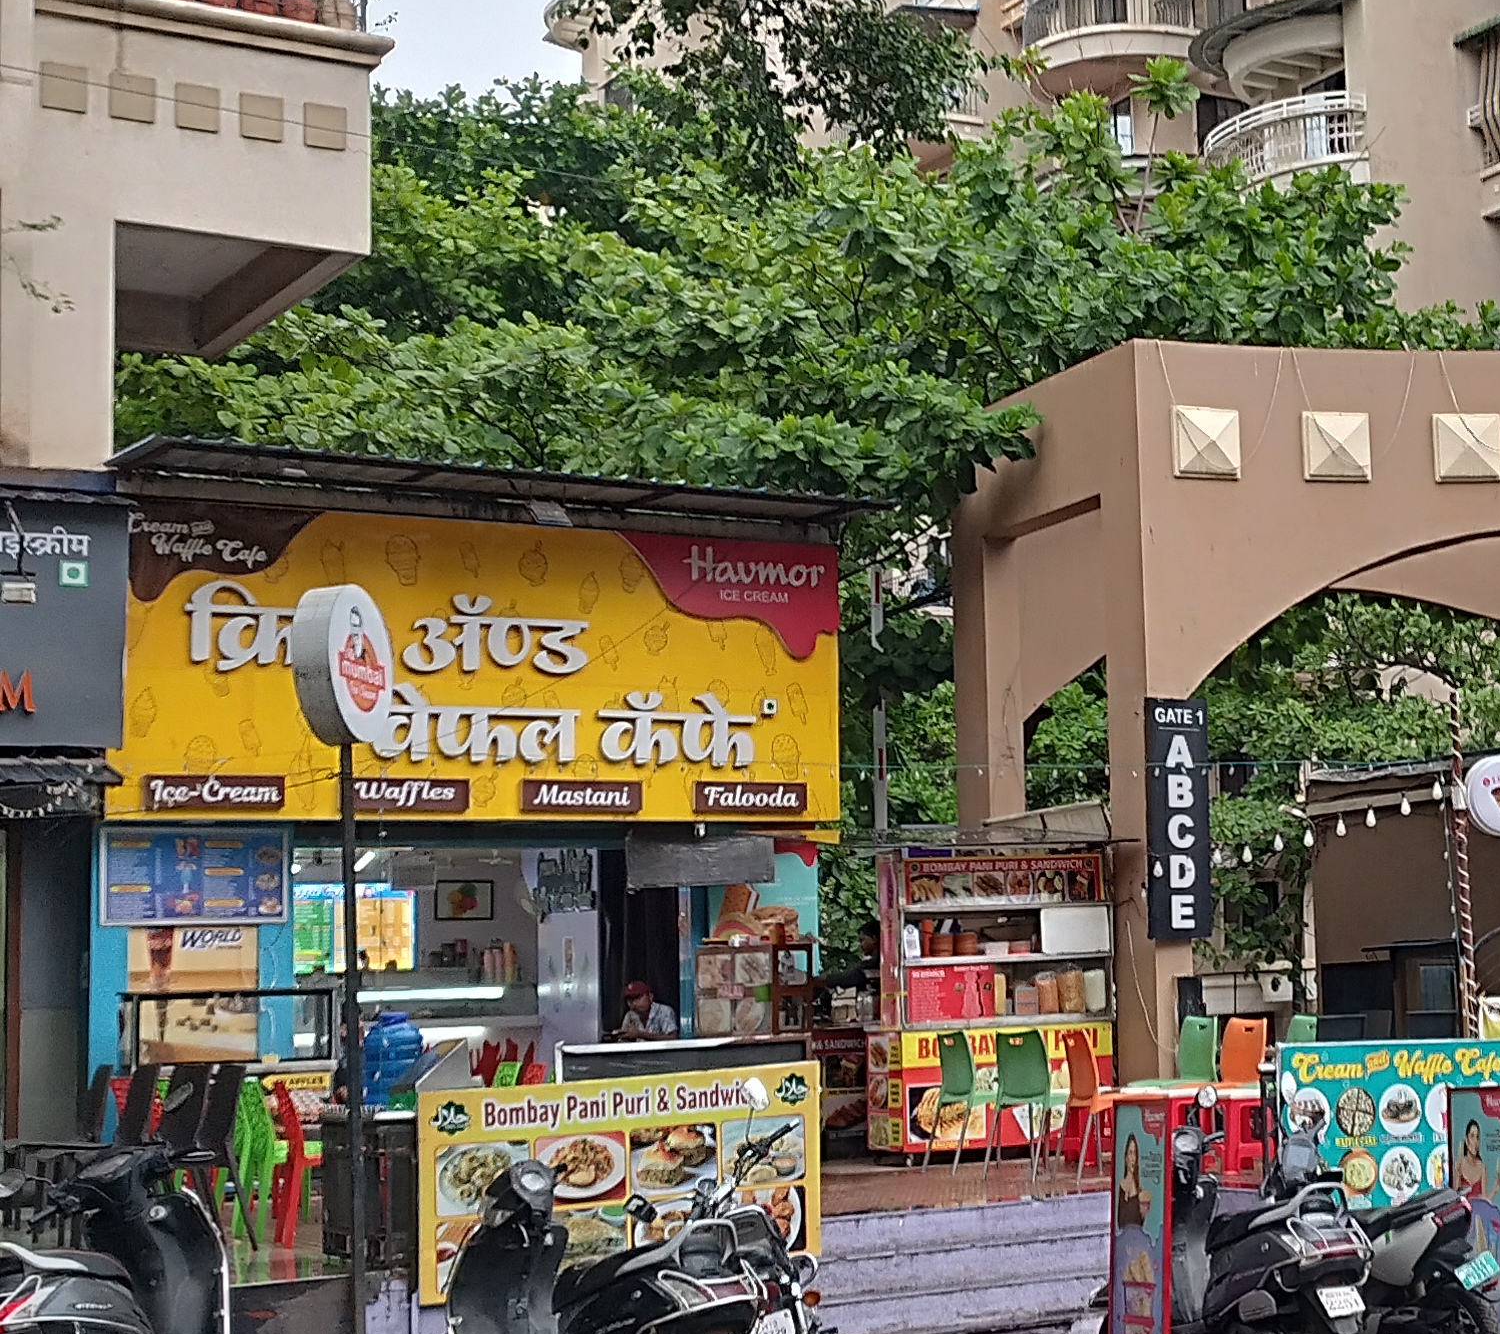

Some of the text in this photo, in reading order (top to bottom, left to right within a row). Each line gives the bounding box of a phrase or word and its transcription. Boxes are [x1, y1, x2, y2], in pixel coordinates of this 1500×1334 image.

[128, 512, 189, 534] Cream
[0, 526, 90, 559] इस्क्रीम
[150, 533, 268, 569] Waffle Cafe
[682, 545, 825, 588] Havmor
[720, 590, 789, 604] ICE CREAM
[1155, 707, 1204, 725] GATE 1
[150, 777, 282, 809] Ice-Cream
[354, 780, 456, 808] Waffles
[532, 784, 631, 807] Mastani
[703, 785, 800, 808] Falooda
[922, 858, 1083, 873] BOMBAY PANI PURI & SANDWICH
[1292, 1053, 1364, 1083] Cream
[1394, 1049, 1453, 1084] Waffle
[484, 1099, 561, 1129] Bombay
[565, 1092, 607, 1121] Pani
[613, 1087, 651, 1117] Puri
[657, 1085, 670, 1113] &
